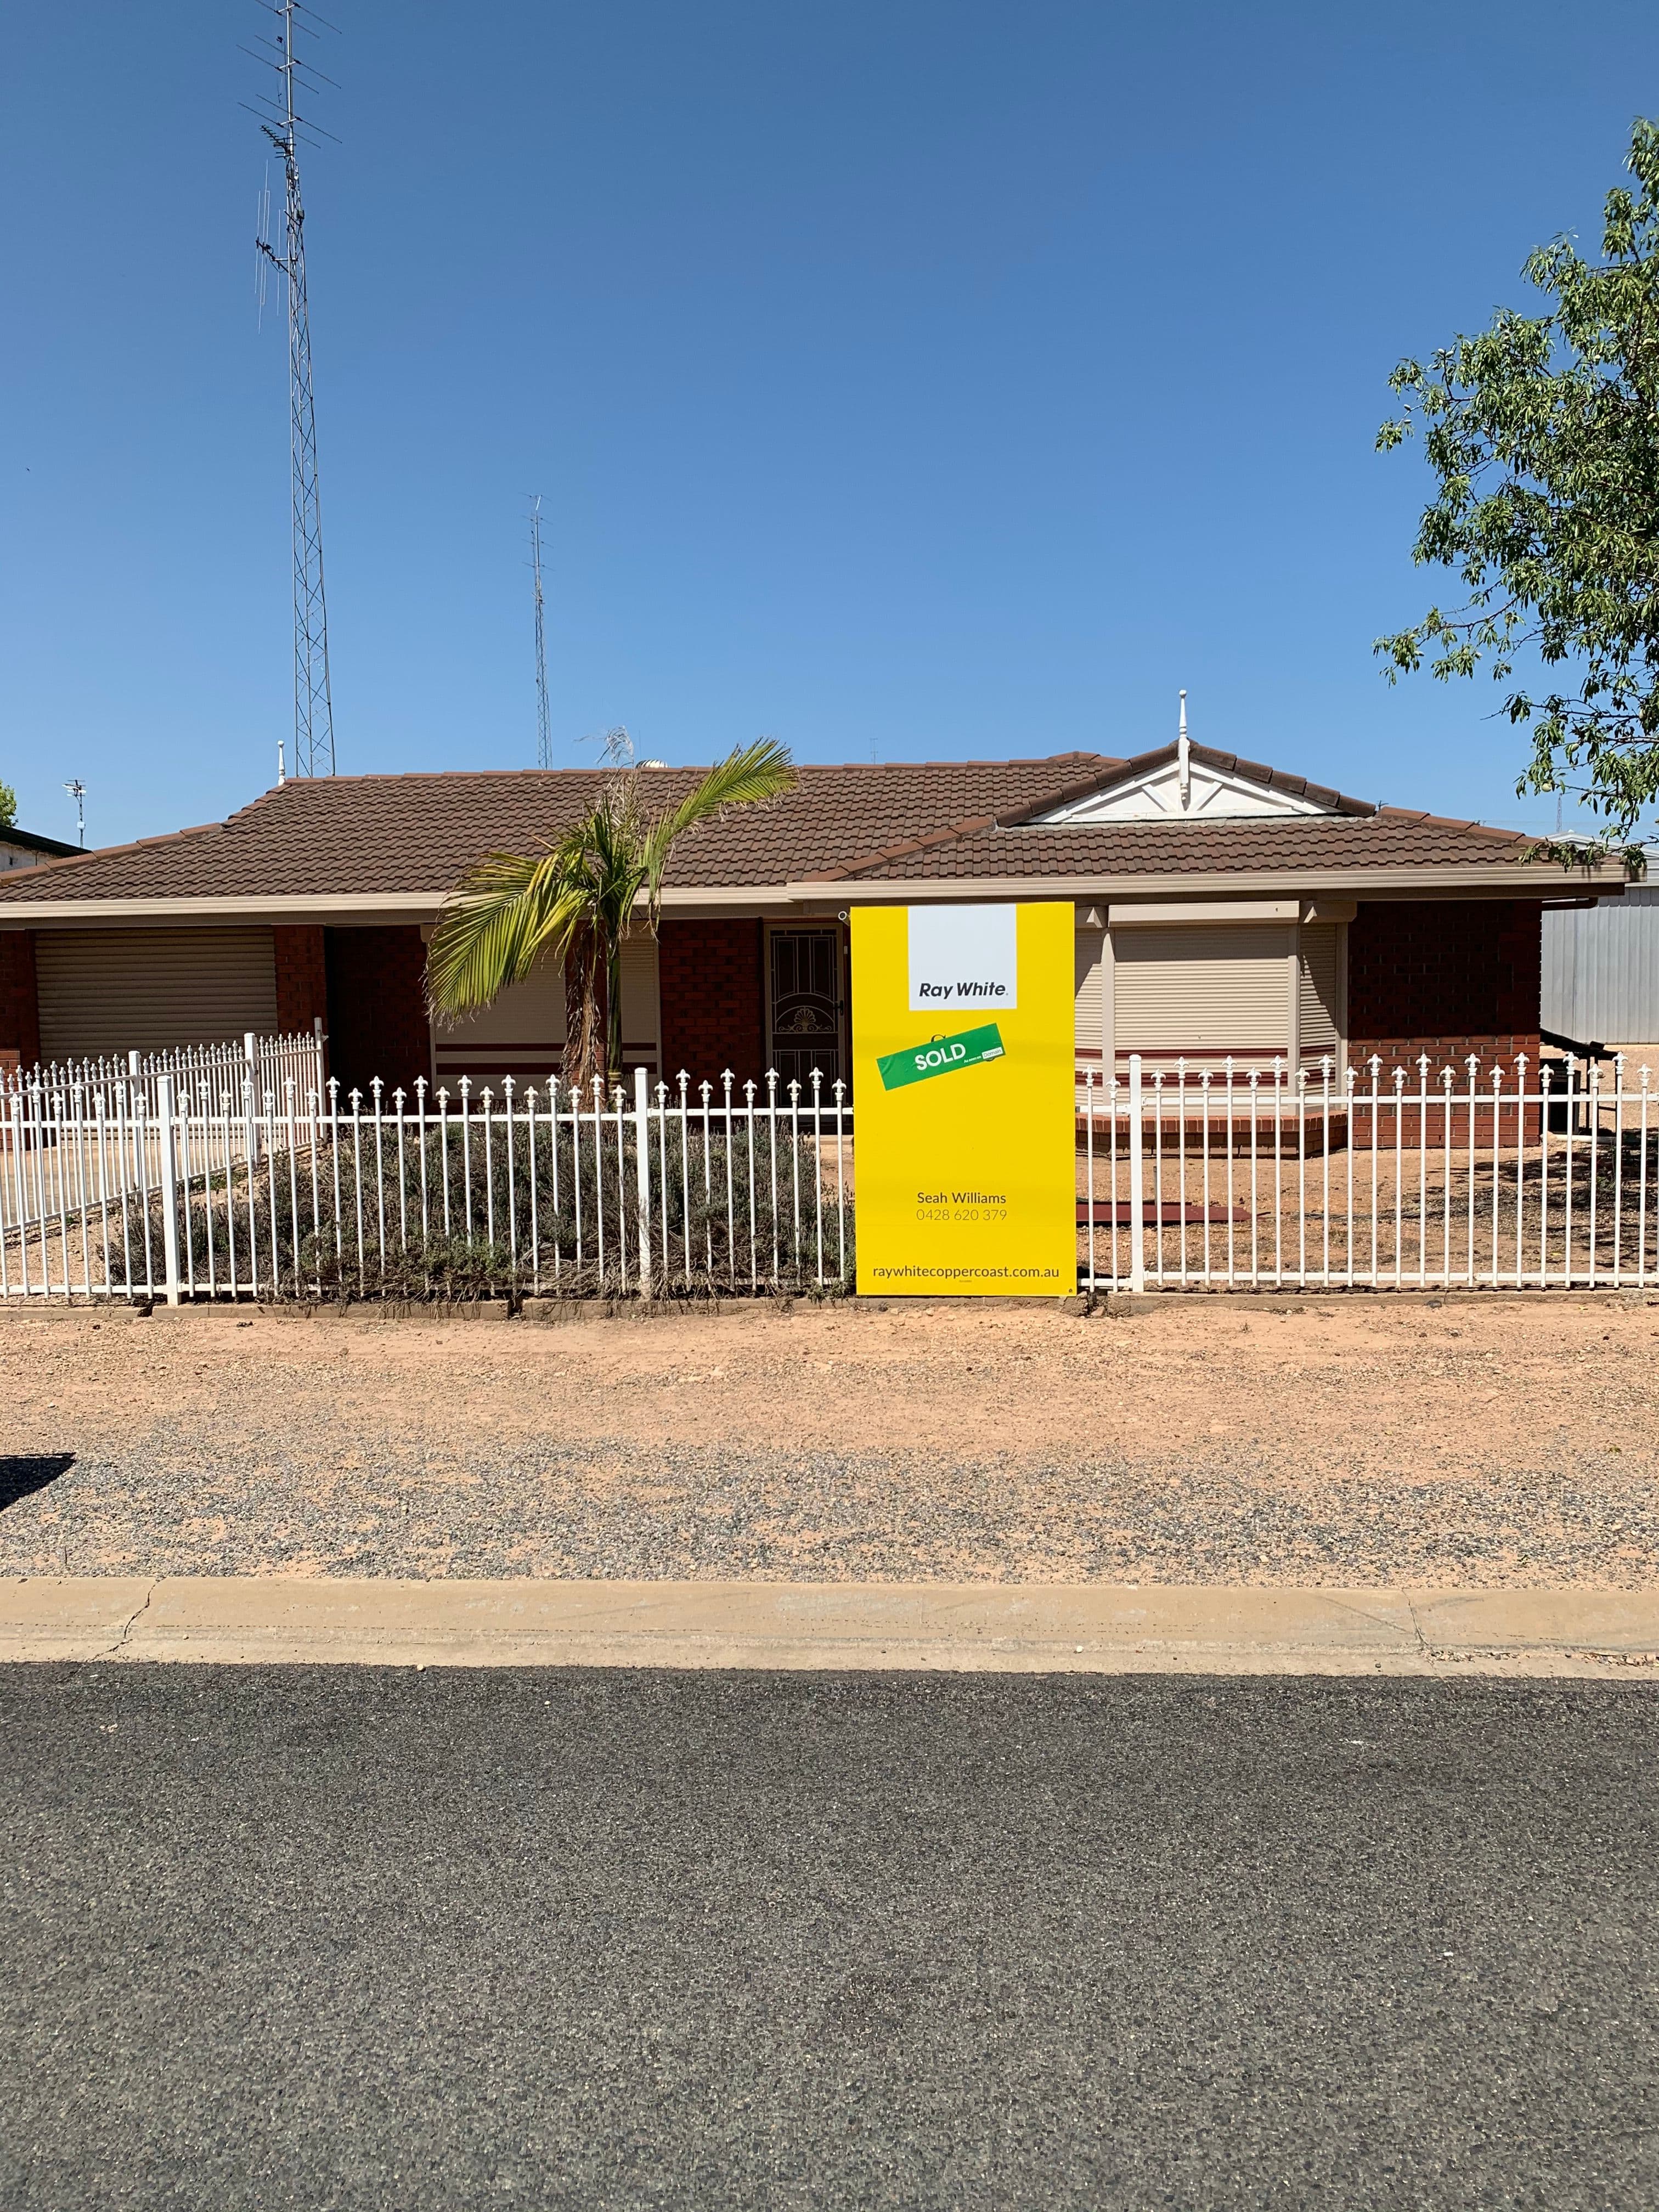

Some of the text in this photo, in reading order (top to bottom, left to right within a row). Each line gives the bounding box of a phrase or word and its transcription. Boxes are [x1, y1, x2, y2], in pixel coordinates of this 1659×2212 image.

[919, 983, 953, 1000] Ray
[915, 1043, 966, 1070] SOLD
[983, 1049, 1001, 1058] Domain
[917, 1192, 1007, 1204] Seah Williams
[916, 1209, 1007, 1221] 0428 620 379
[873, 1265, 1059, 1279] raywhitecoppercoast.com.au
